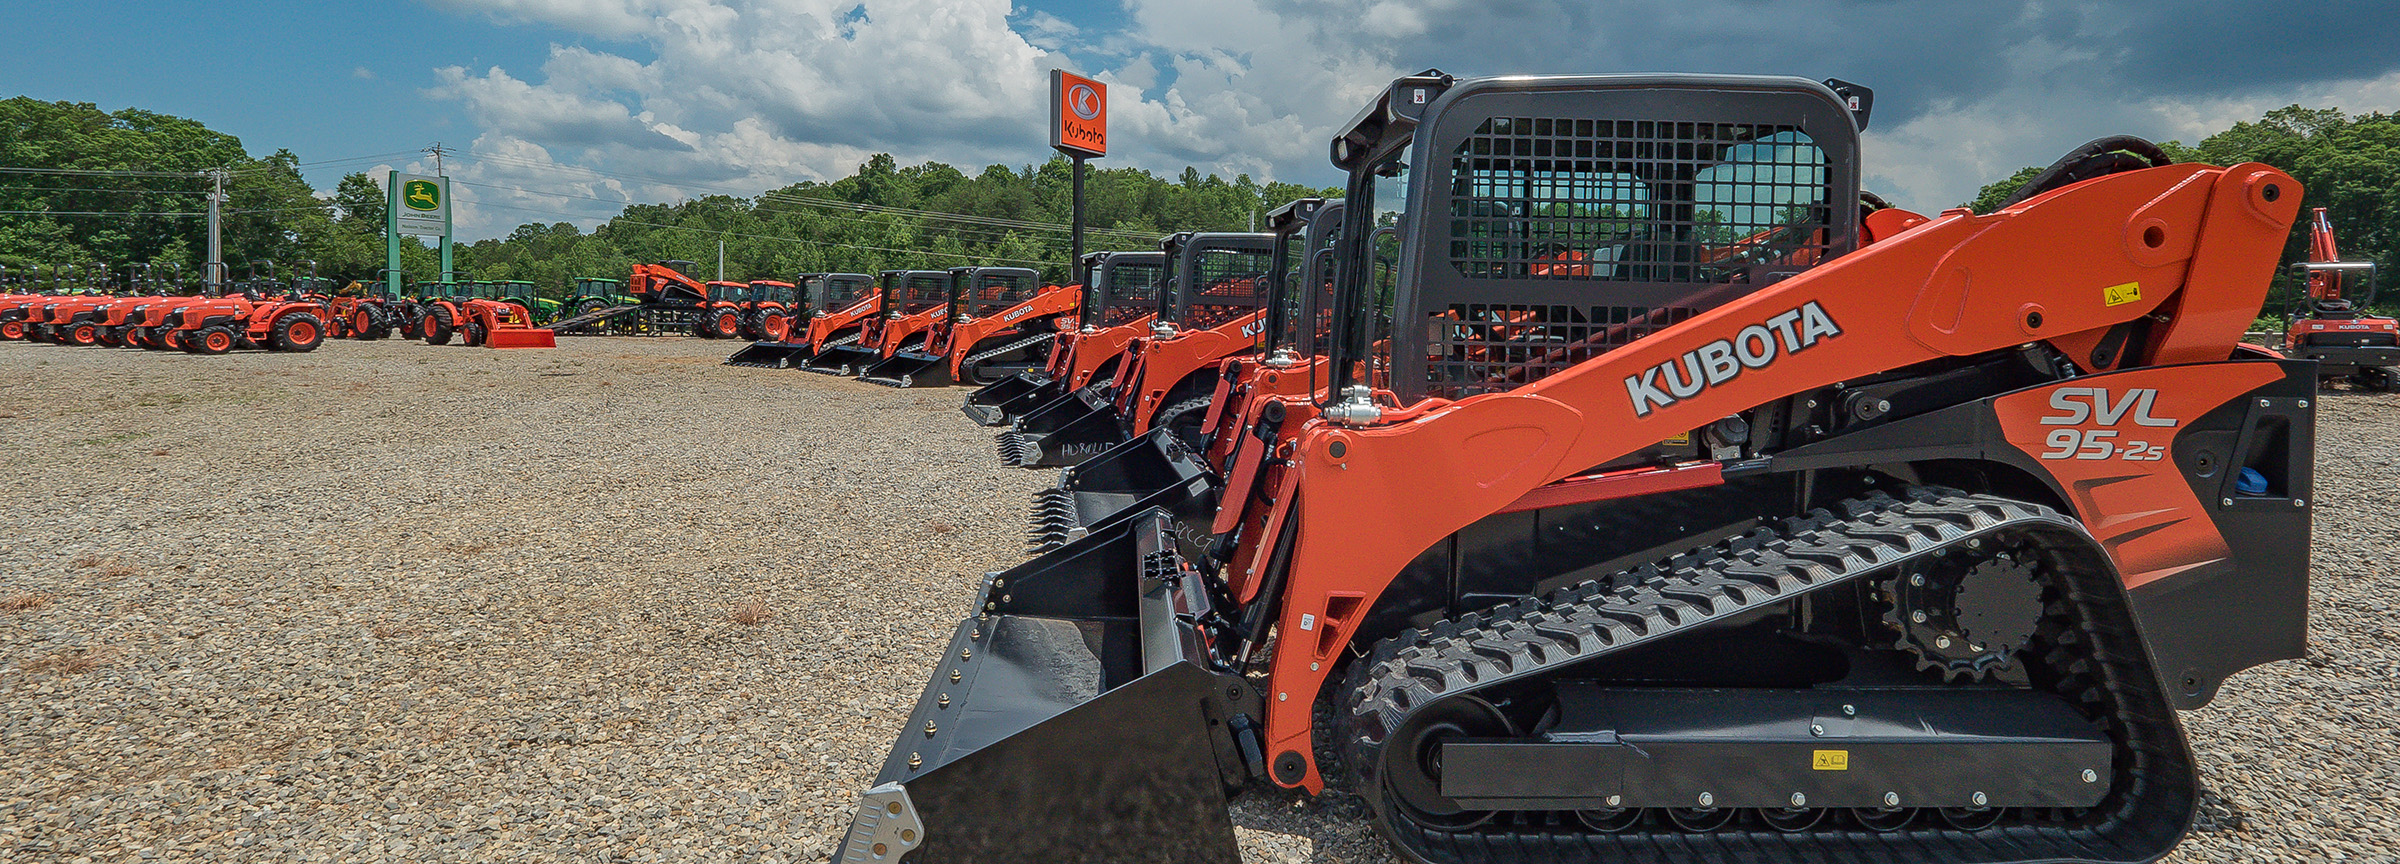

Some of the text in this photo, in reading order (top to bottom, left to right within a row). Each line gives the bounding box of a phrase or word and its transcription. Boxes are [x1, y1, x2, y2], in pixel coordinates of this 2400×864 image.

[1064, 120, 1104, 144] Kubota
[849, 303, 873, 317] KUBOTA
[1003, 305, 1034, 323] KUBOTA
[1623, 299, 1843, 417] KUBOTA
[2040, 387, 2178, 427] SVL
